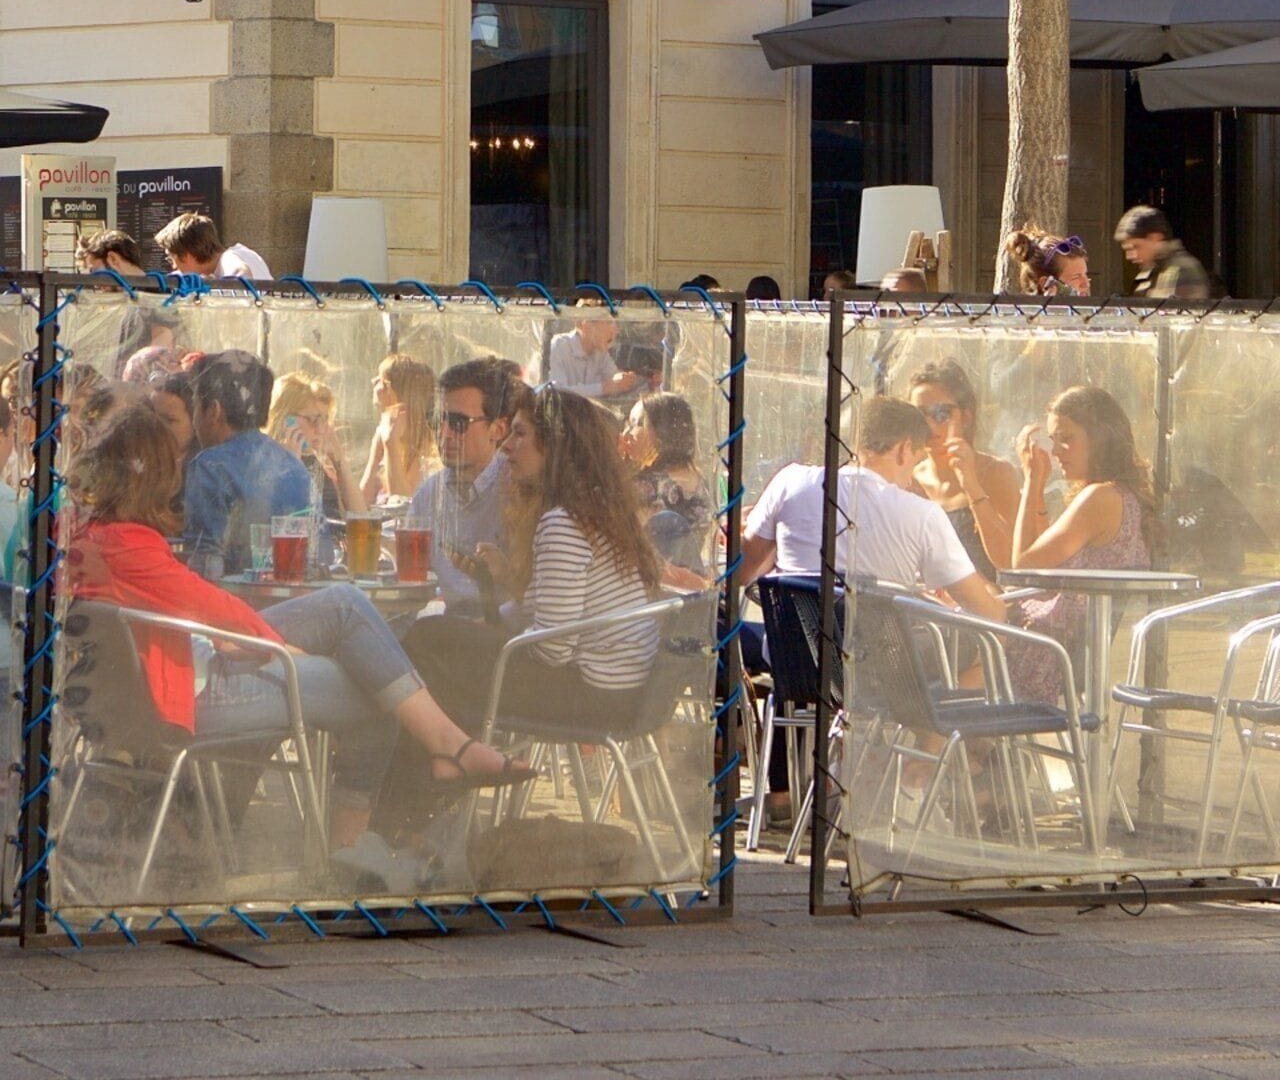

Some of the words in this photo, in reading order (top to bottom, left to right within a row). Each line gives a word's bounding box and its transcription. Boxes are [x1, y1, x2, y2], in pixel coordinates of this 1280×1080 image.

[39, 161, 111, 191] pavillon
[139, 175, 191, 199] pavillon
[64, 200, 97, 215] pavillon
